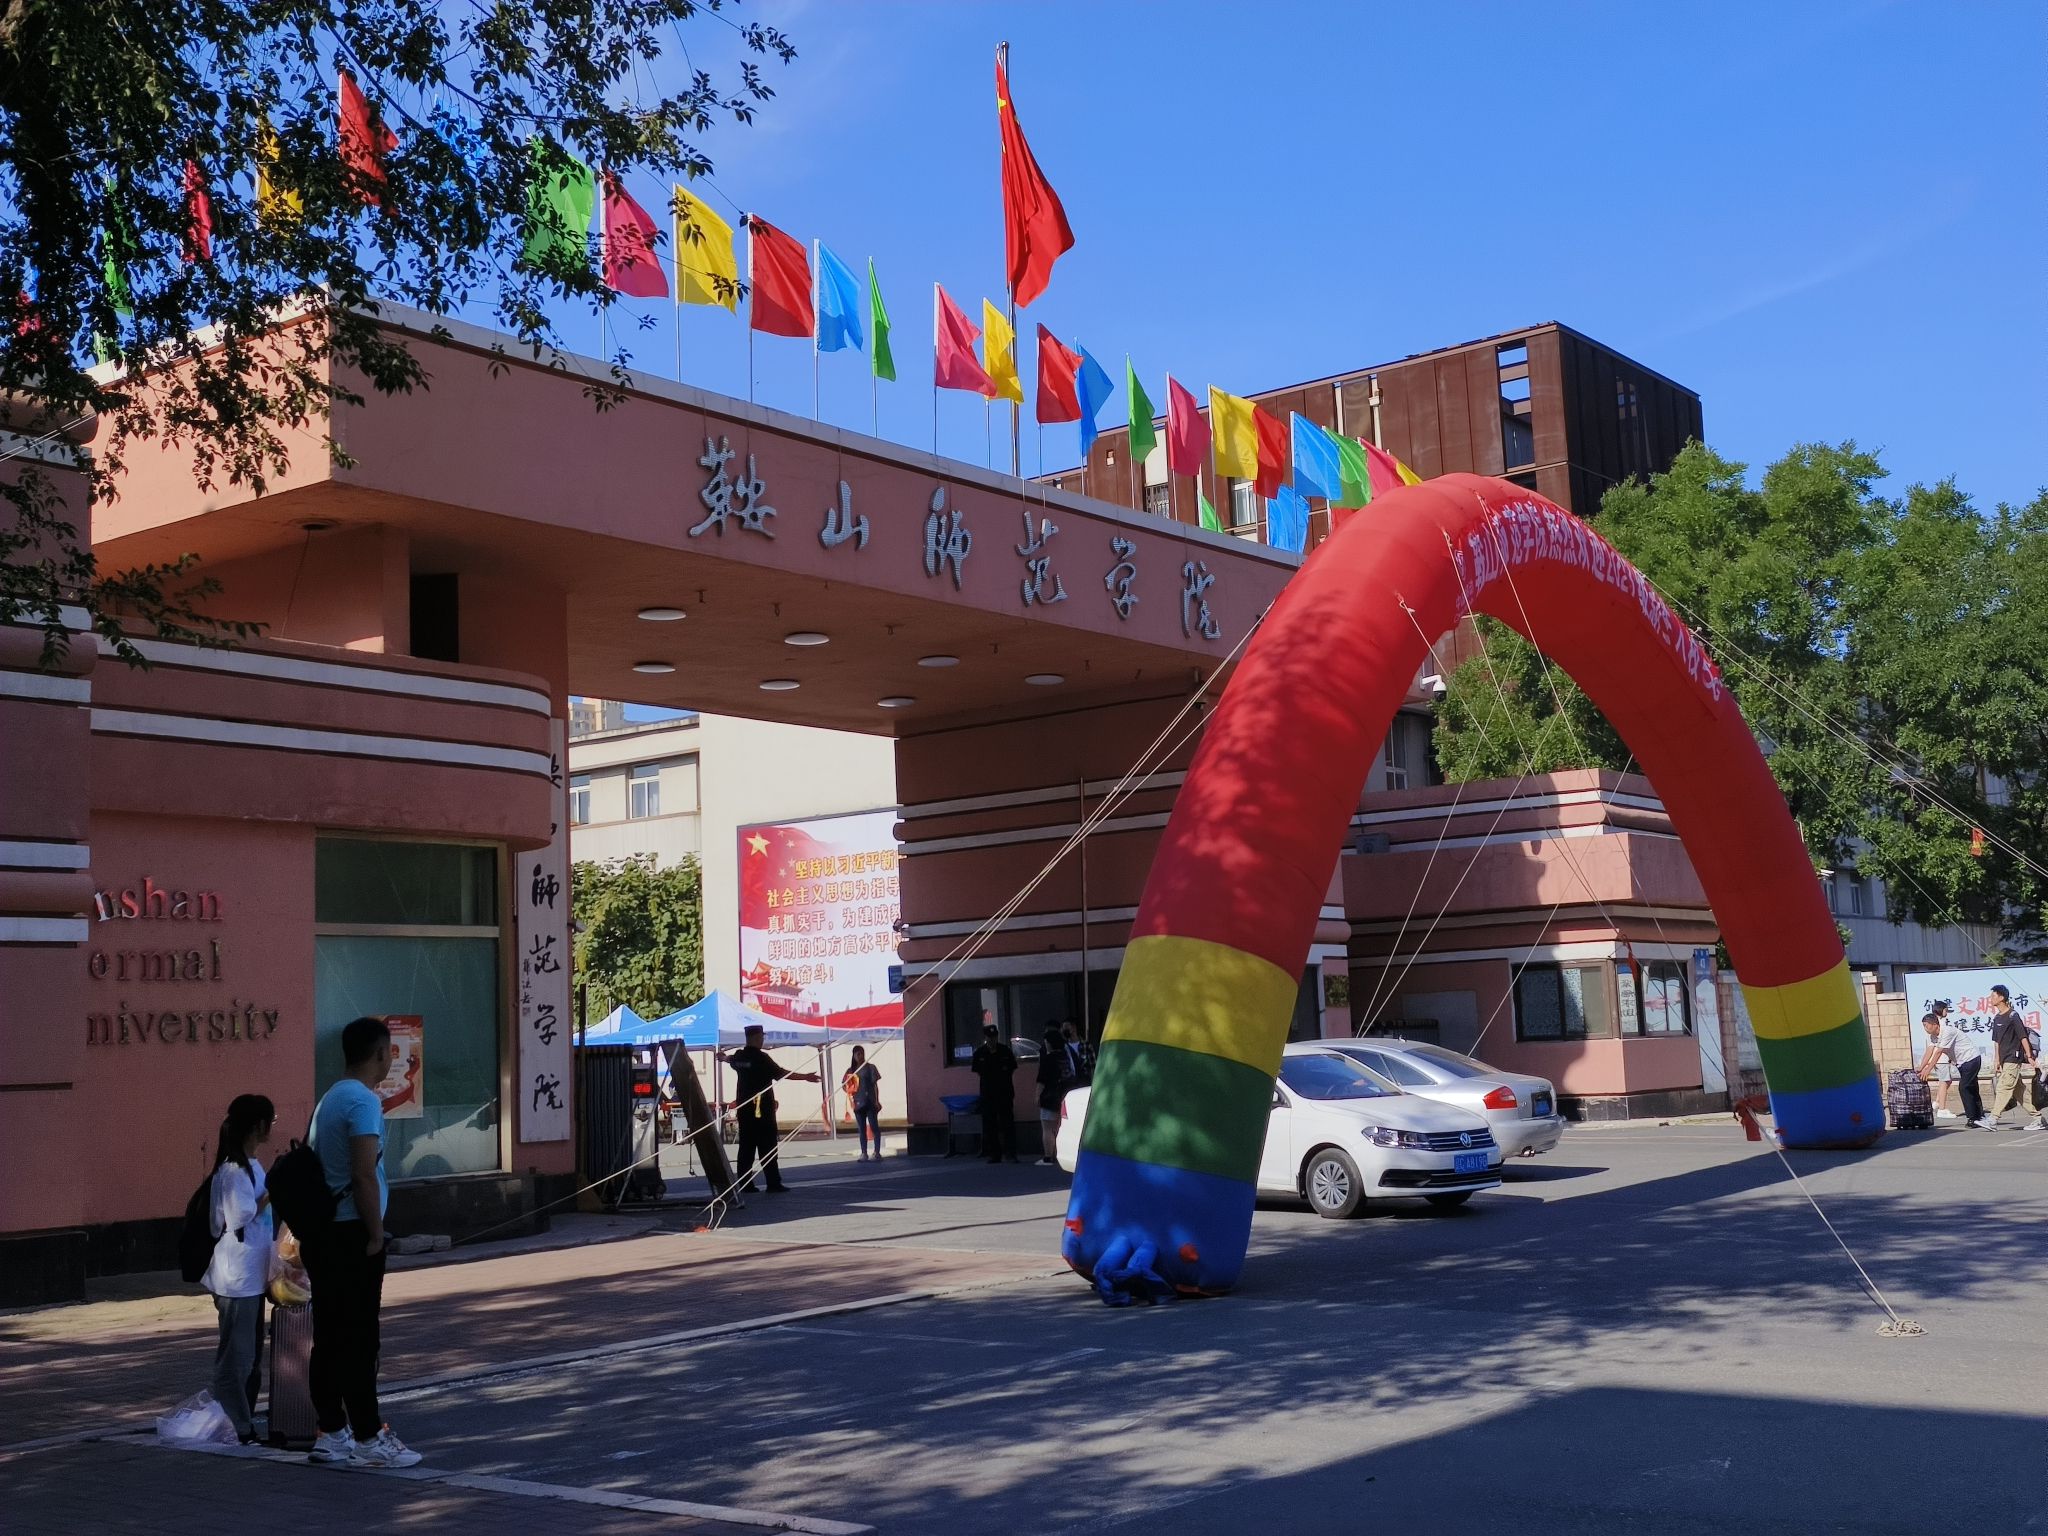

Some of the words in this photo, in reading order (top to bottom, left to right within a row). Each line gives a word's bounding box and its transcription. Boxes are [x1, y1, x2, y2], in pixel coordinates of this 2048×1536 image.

[794, 849, 901, 880] 坚持以习近平新
[85, 999, 281, 1046] niversity
